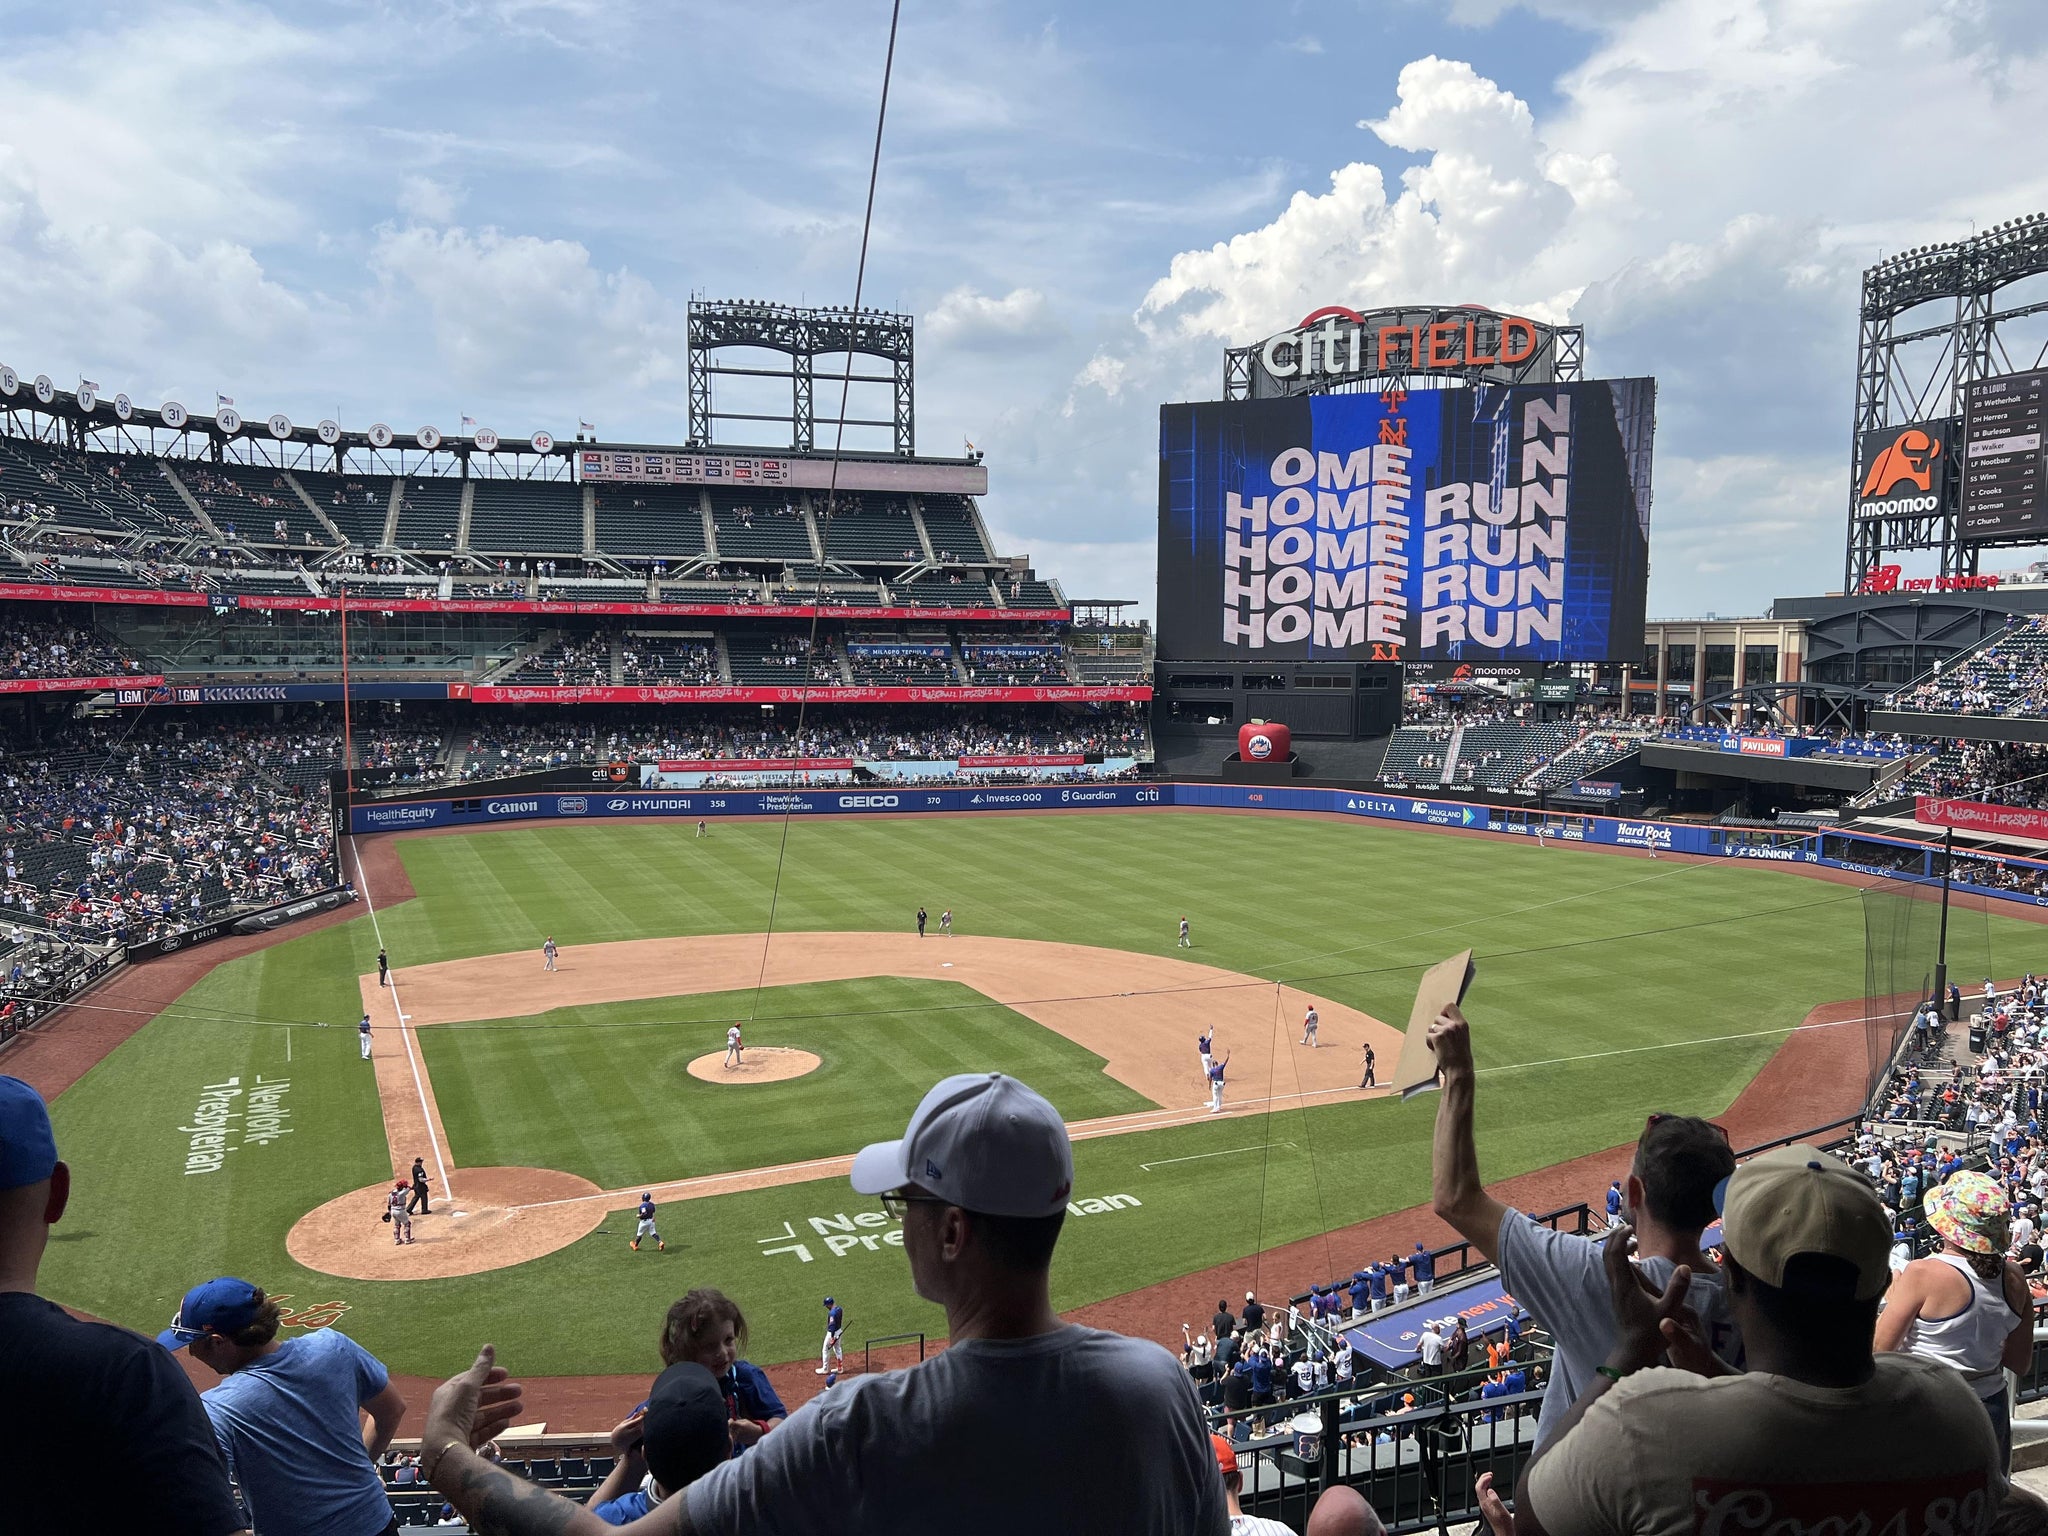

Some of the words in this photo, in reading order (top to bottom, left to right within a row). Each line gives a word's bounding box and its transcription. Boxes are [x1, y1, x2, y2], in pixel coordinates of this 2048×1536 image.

[1263, 318, 1361, 377] citi
[1378, 318, 1537, 370] FIELD
[4, 375, 13, 388] 16
[38, 383, 50, 396] 24
[1989, 383, 2007, 394] LOUIS
[82, 392, 91, 404] 17
[1984, 395, 2021, 406] Wetherholt
[118, 401, 129, 413] 36
[168, 409, 180, 421] 31
[223, 415, 234, 427] 41
[1983, 414, 2008, 422] Herrera
[275, 421, 285, 432] 14
[323, 426, 336, 438] 37
[1982, 428, 2010, 436] Burleson
[478, 435, 495, 445] SHEA
[535, 437, 549, 447] 42
[1982, 443, 2004, 451] Walker
[1270, 445, 1413, 490] OME
[1981, 457, 2011, 466] Nootbaar
[1979, 487, 2002, 496] Crooks
[1226, 485, 1411, 532] HOME
[1424, 478, 1568, 528] RUN
[1860, 496, 1938, 517] moomoo
[1977, 517, 2000, 525] Church
[1225, 524, 1410, 571] HOME
[1423, 520, 1566, 568] RUN
[1224, 563, 1408, 610] HOME
[1422, 561, 1565, 608] RUN
[1904, 577, 1933, 591] new
[1936, 574, 1999, 589] balance
[1223, 604, 1407, 649] HOME
[1420, 603, 1563, 649] RUN
[120, 690, 141, 703] LGM
[179, 690, 199, 701] LGM
[455, 685, 464, 696] 7
[1724, 739, 1738, 749] citi
[1743, 741, 1781, 752] PAVILION
[592, 768, 607, 777] citi
[987, 794, 1021, 802] Invesco
[1022, 793, 1041, 801] QQQ
[1072, 791, 1116, 800] Guardian
[1136, 789, 1159, 801] citi
[1581, 787, 1612, 796] $20,055
[632, 800, 690, 809] HYUNDAI
[839, 795, 898, 808] GEICO
[927, 797, 941, 805] 370
[1359, 800, 1395, 812] DELTA
[488, 802, 538, 814] Canon
[1428, 810, 1461, 818] HAUGLAND
[367, 808, 435, 821] HealthEquity
[1488, 822, 1501, 830] 380
[1508, 824, 1527, 832] GOYA
[1618, 823, 1645, 836] Hard
[1645, 826, 1672, 841] Rock
[1563, 830, 1583, 838] GOYA
[1749, 848, 1795, 860] DUNKIN'
[1805, 853, 1817, 862] 370
[1841, 863, 1891, 877] CADILLAC
[199, 928, 218, 938] DELTA
[165, 939, 178, 949] Ford
[177, 1089, 243, 1175] Presbyterian
[1400, 1331, 1418, 1341] citi
[1423, 1315, 1458, 1330] the
[1457, 1301, 1499, 1319] new
[1301, 1372, 1310, 1381] 22
